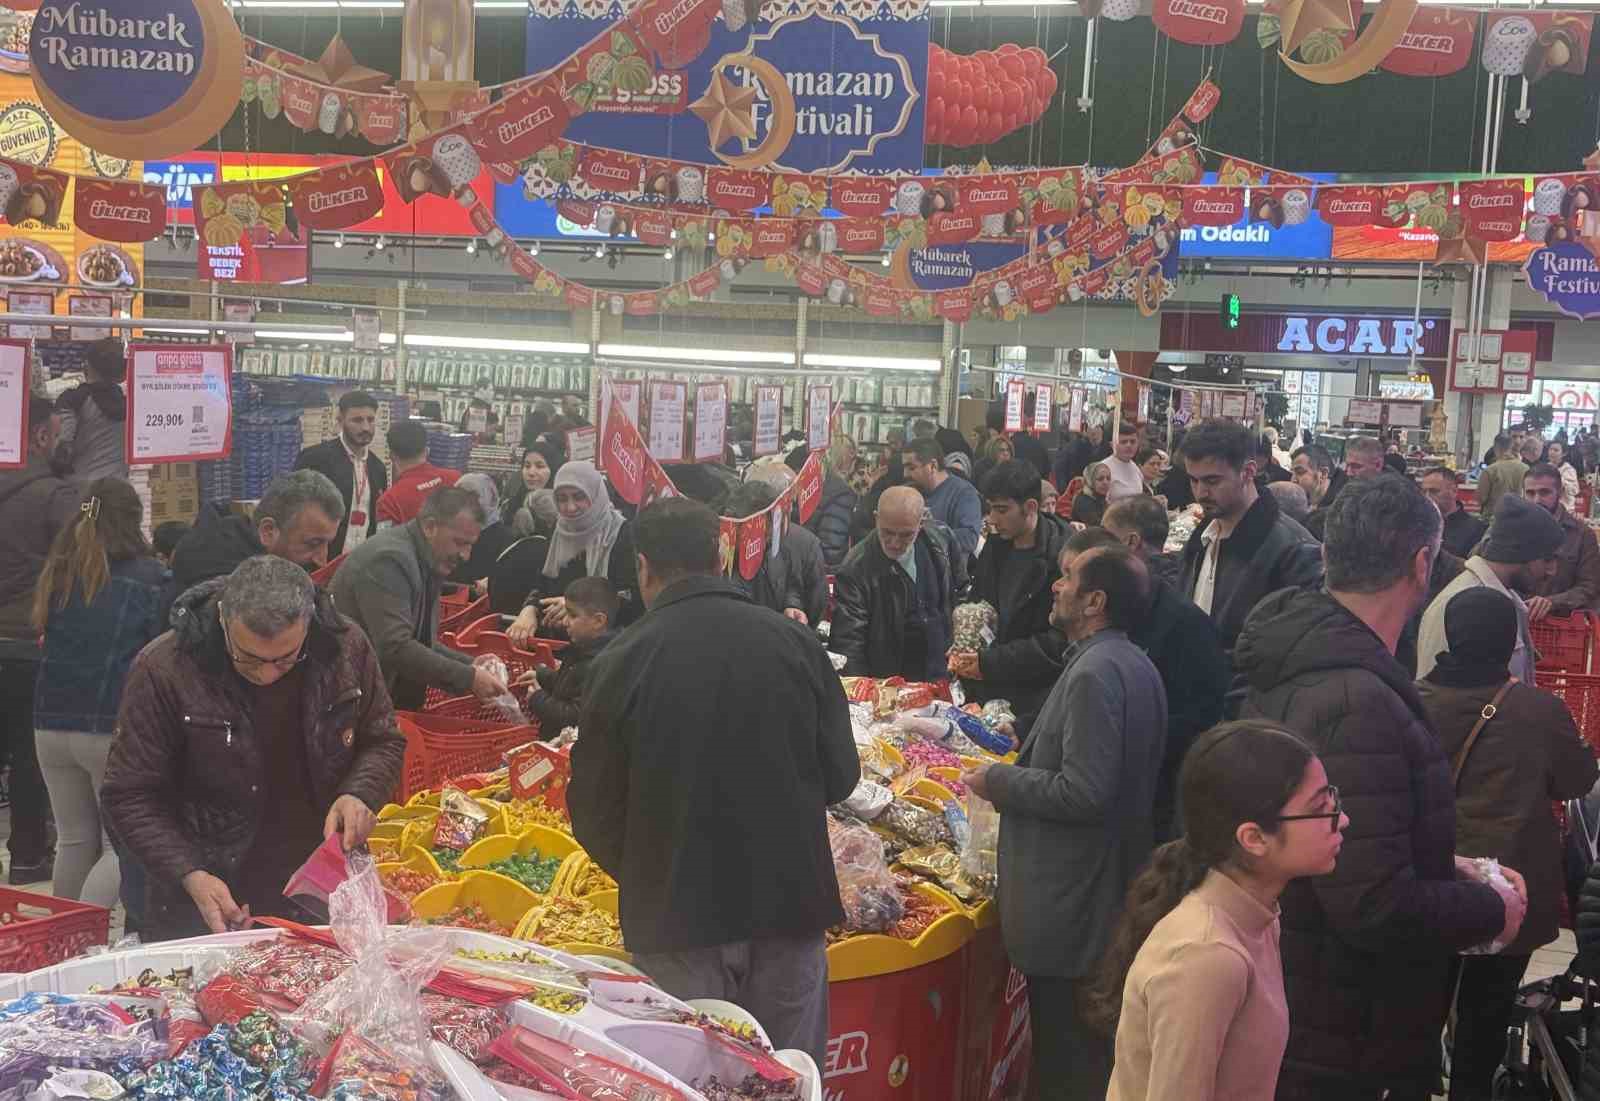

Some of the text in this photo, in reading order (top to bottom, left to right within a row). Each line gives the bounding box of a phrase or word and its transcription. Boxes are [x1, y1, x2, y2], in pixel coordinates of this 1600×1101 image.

[42, 3, 192, 48] Mübarek
[39, 36, 194, 77] Ramazan
[734, 64, 895, 100] Rmazan
[6, 110, 30, 124] TAZE
[499, 106, 554, 144] ÜLKER
[0, 125, 48, 153] GÜVENİLİR
[309, 187, 367, 213] ÜLKER
[1193, 199, 1234, 214] ÜLKER
[1330, 199, 1371, 214] ÜLKER
[1471, 194, 1513, 208] ÜLKER
[90, 200, 151, 224] ÜLKER
[1201, 225, 1270, 242] Odaklı
[206, 242, 244, 256] TEKSTİL
[912, 247, 971, 266] Mübarek
[912, 260, 973, 279] Ramazan
[1277, 317, 1425, 355] ACAR
